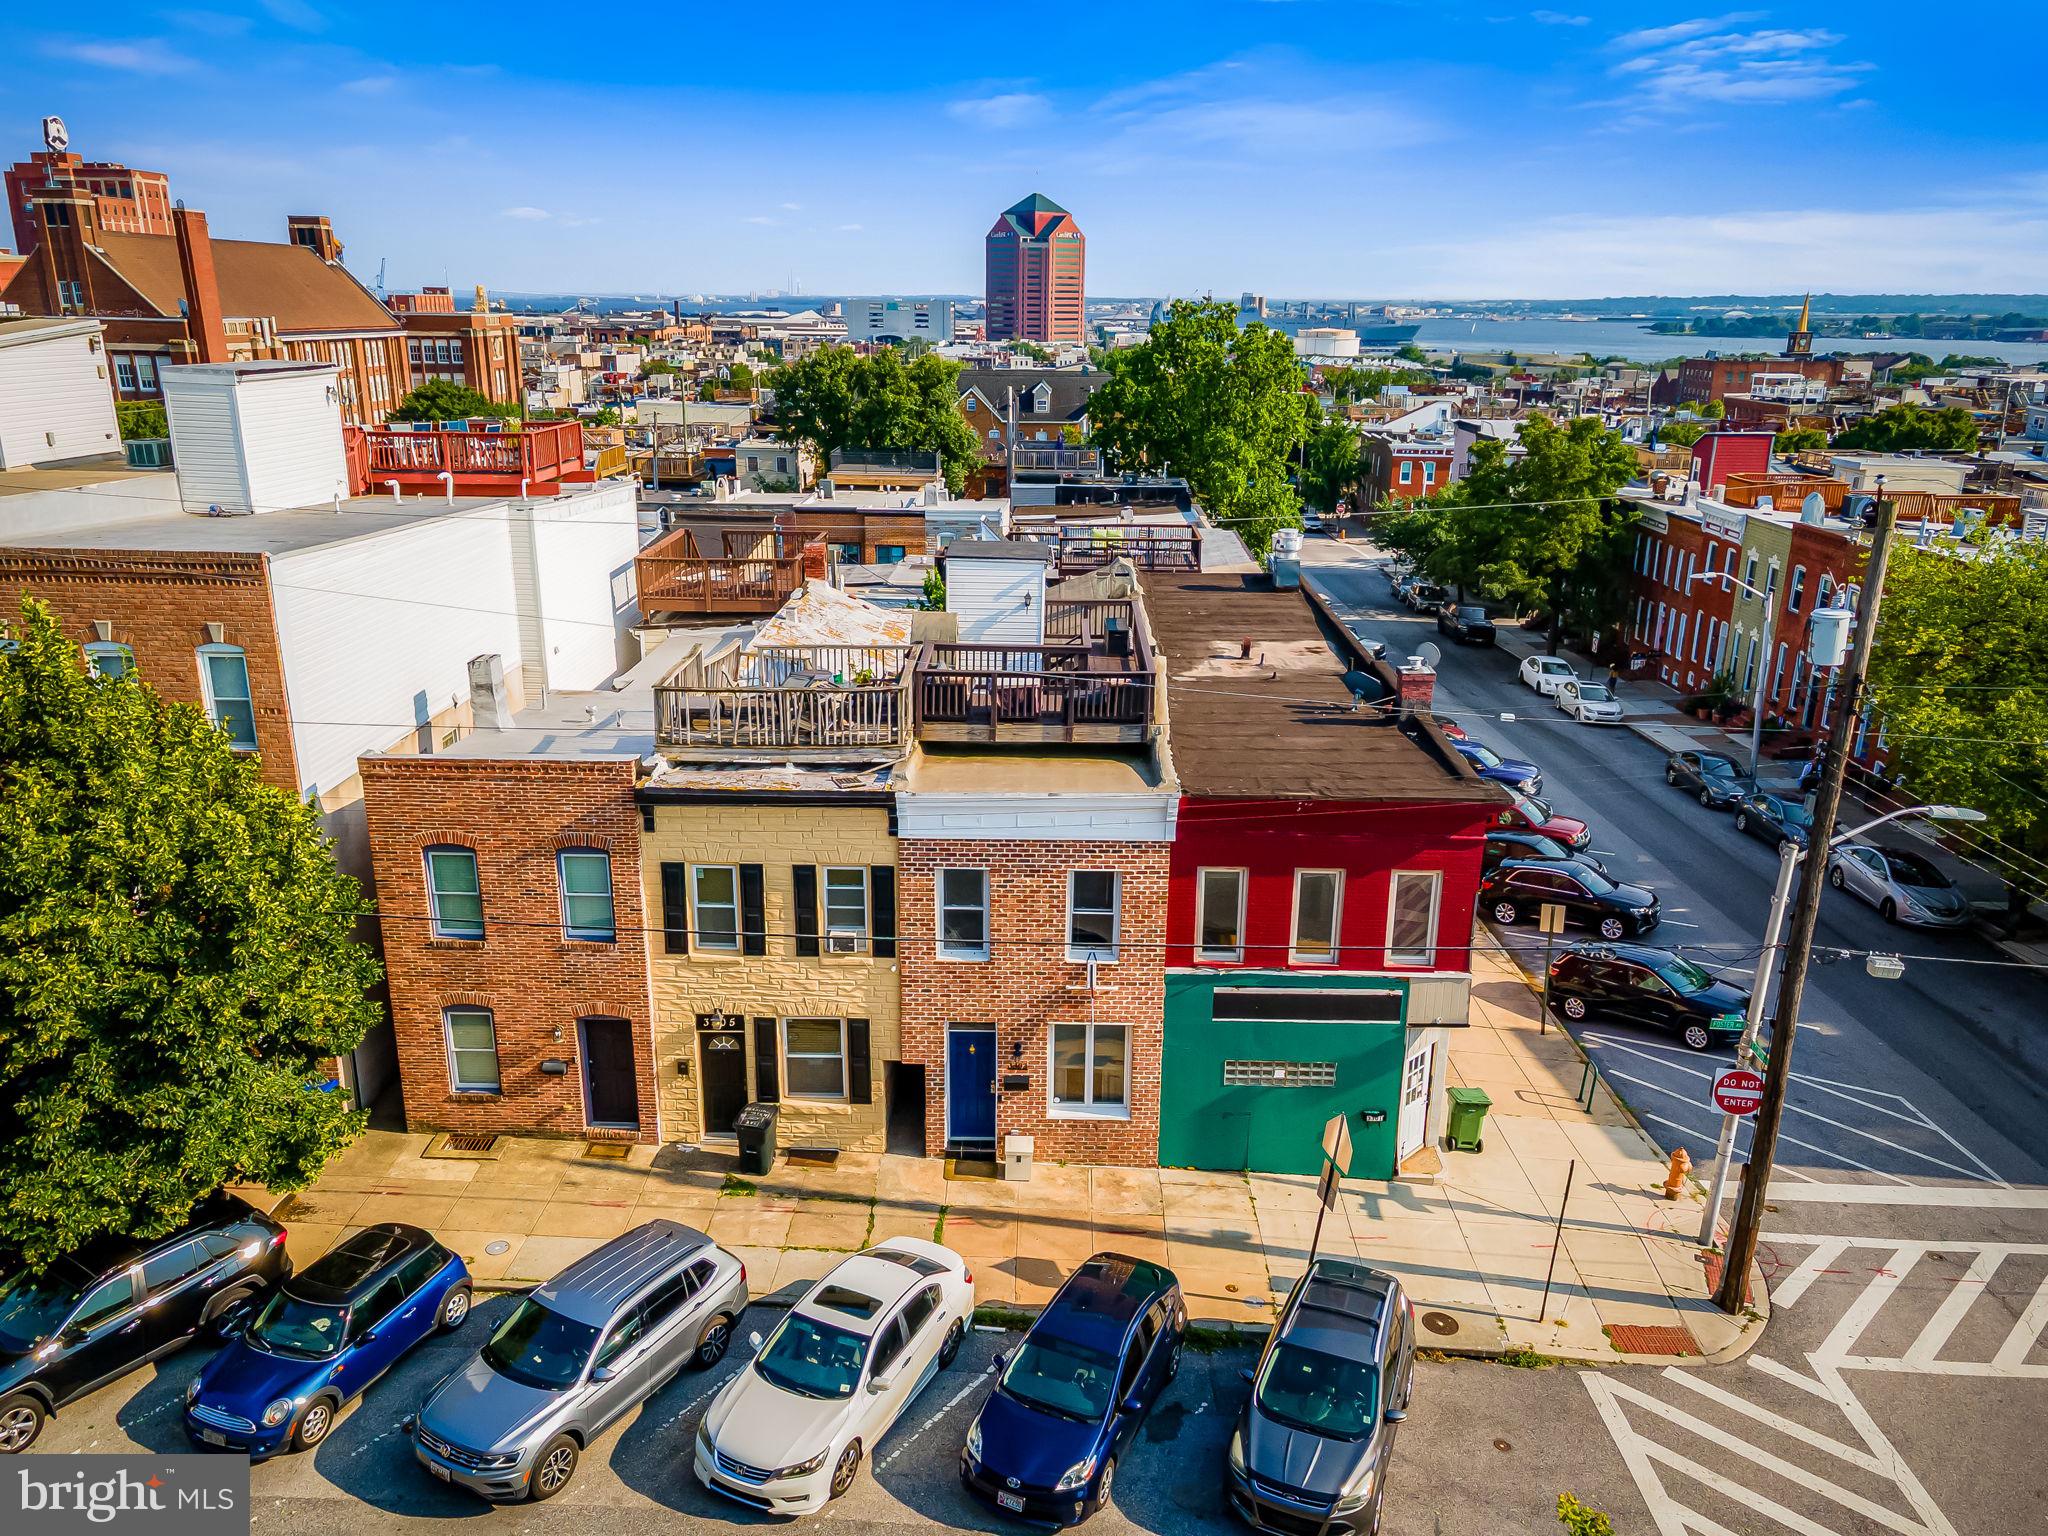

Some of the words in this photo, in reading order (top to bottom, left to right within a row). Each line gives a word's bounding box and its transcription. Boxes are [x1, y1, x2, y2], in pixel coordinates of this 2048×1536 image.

[703, 1017, 736, 1027] 305
[1712, 1020, 1735, 1029] FOSTER
[1723, 1078, 1737, 1086] DO
[1741, 1080, 1760, 1088] NOT
[1723, 1098, 1754, 1107] ENTER
